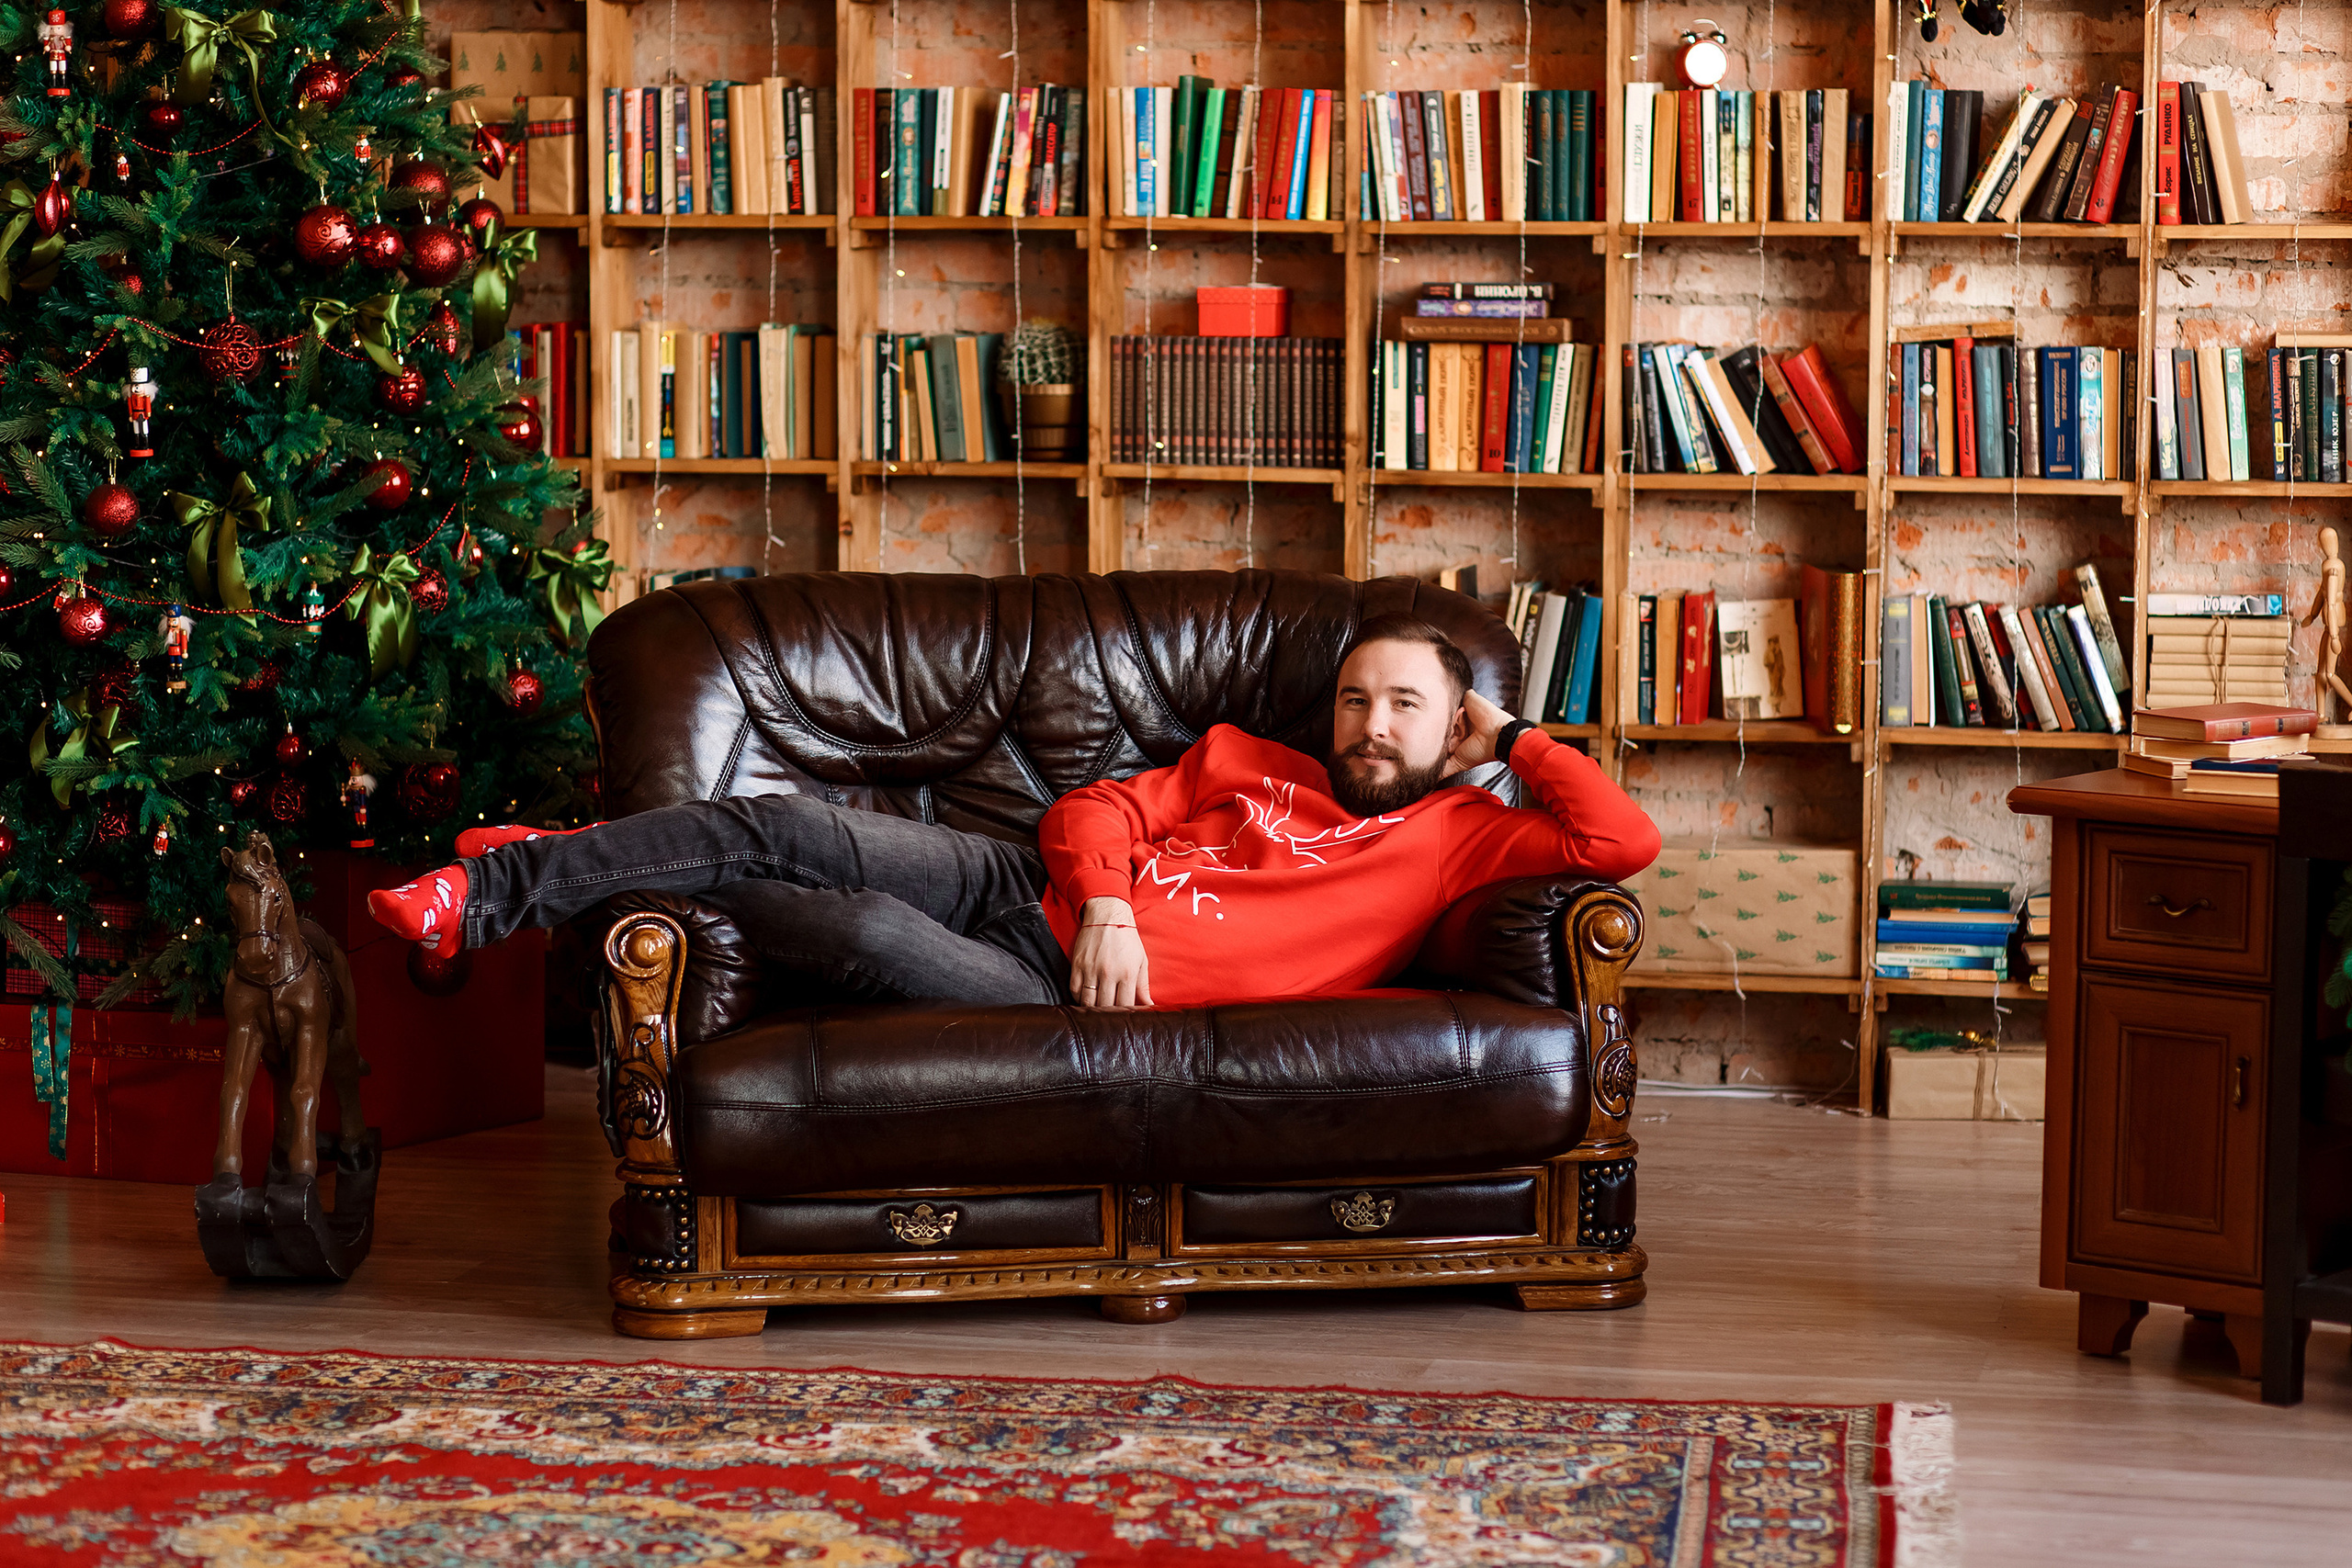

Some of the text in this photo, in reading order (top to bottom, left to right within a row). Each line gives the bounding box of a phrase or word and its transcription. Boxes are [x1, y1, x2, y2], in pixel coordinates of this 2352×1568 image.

[2164, 103, 2173, 193] Борис РУДЕНКО
[2188, 114, 2202, 185] ВЯЗАНИЕ НА СПИЦАХ
[2272, 355, 2282, 409] МАРИНИНА
[1136, 857, 1225, 920] Mr.
